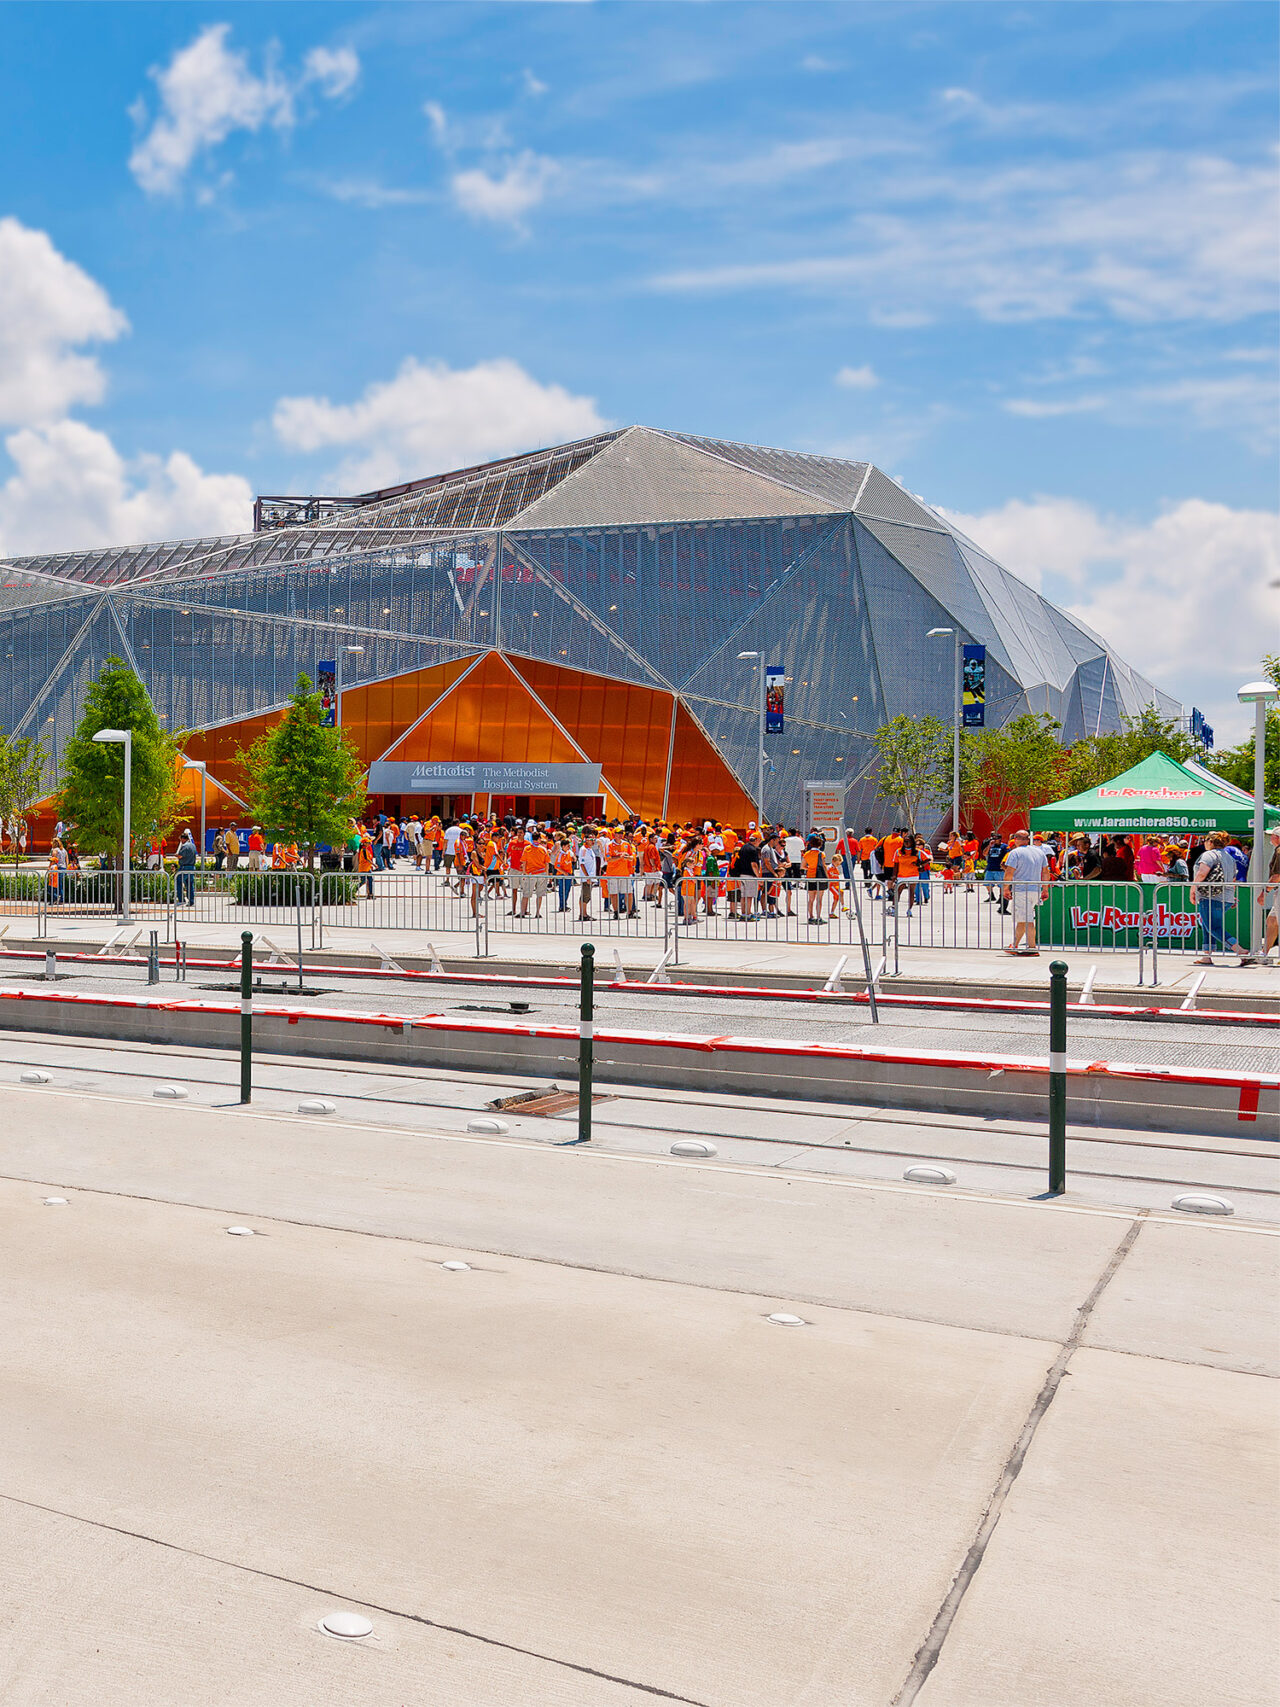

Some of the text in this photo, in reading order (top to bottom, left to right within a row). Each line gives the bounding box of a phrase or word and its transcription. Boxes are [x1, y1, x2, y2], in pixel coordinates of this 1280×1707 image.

[412, 764, 476, 777] Methodist
[482, 767, 549, 777] The Methodist
[482, 779, 558, 790] Hospital System
[1098, 788, 1120, 798] La
[1120, 787, 1205, 798] Ranchera
[1074, 816, 1217, 828] www.laranchera850.com
[1071, 904, 1203, 932] La Rancher
